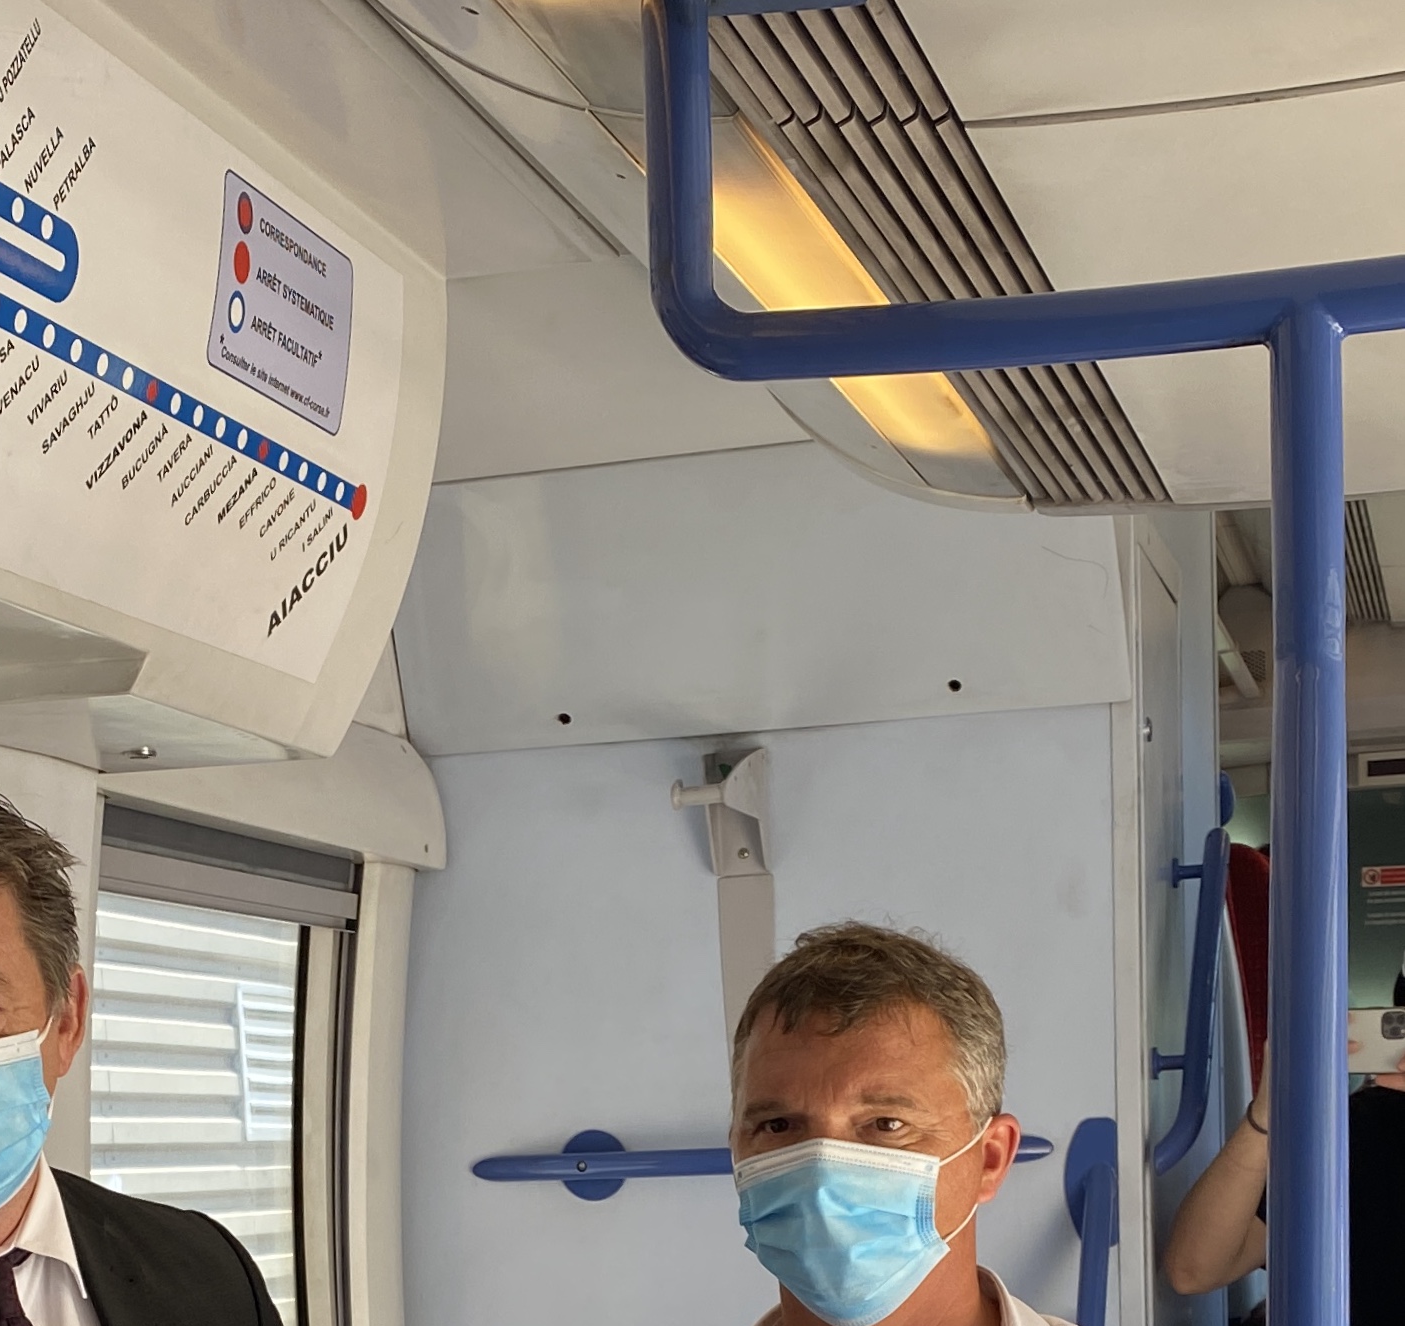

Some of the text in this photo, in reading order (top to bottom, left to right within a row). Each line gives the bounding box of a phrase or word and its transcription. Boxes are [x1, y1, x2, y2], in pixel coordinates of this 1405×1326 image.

[2, 18, 41, 94] POZZATELLU
[24, 127, 63, 194] NUVELLA
[53, 137, 96, 211] PETRALBA
[259, 217, 327, 278] CORRESPONDANCE
[27, 369, 67, 425] VIVARIU
[42, 381, 95, 454] SAVAGHJU
[86, 410, 147, 489] VIZZAVONA
[157, 433, 192, 482] TAVERA
[172, 444, 213, 507] AUCCIANI
[185, 455, 237, 525] CARBUCCIA
[218, 468, 257, 524] MEZANA
[239, 477, 276, 529] EFFRICO
[260, 488, 294, 537] CAVONE
[270, 499, 316, 561] U RICANTU
[307, 507, 333, 546] SALINI
[268, 523, 347, 637] AIACCIU
